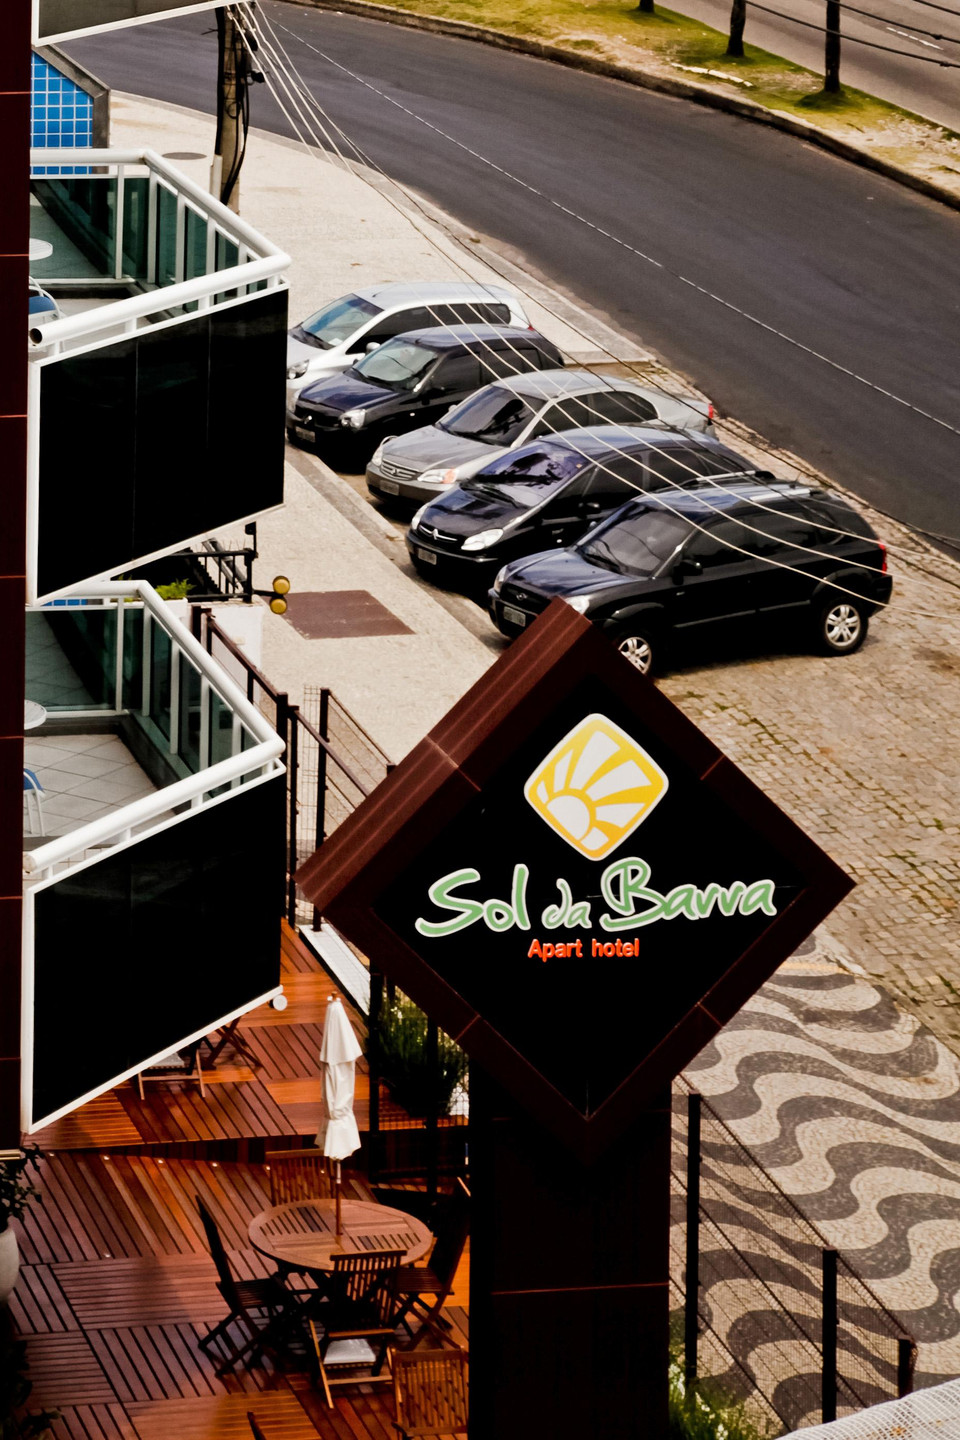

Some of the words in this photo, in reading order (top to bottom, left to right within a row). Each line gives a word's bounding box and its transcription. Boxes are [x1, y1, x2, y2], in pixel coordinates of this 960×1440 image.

[414, 863, 532, 938] Sol
[541, 877, 593, 930] da
[599, 856, 778, 933] Barra
[527, 938, 584, 963] Apart
[591, 937, 640, 958] hotel
